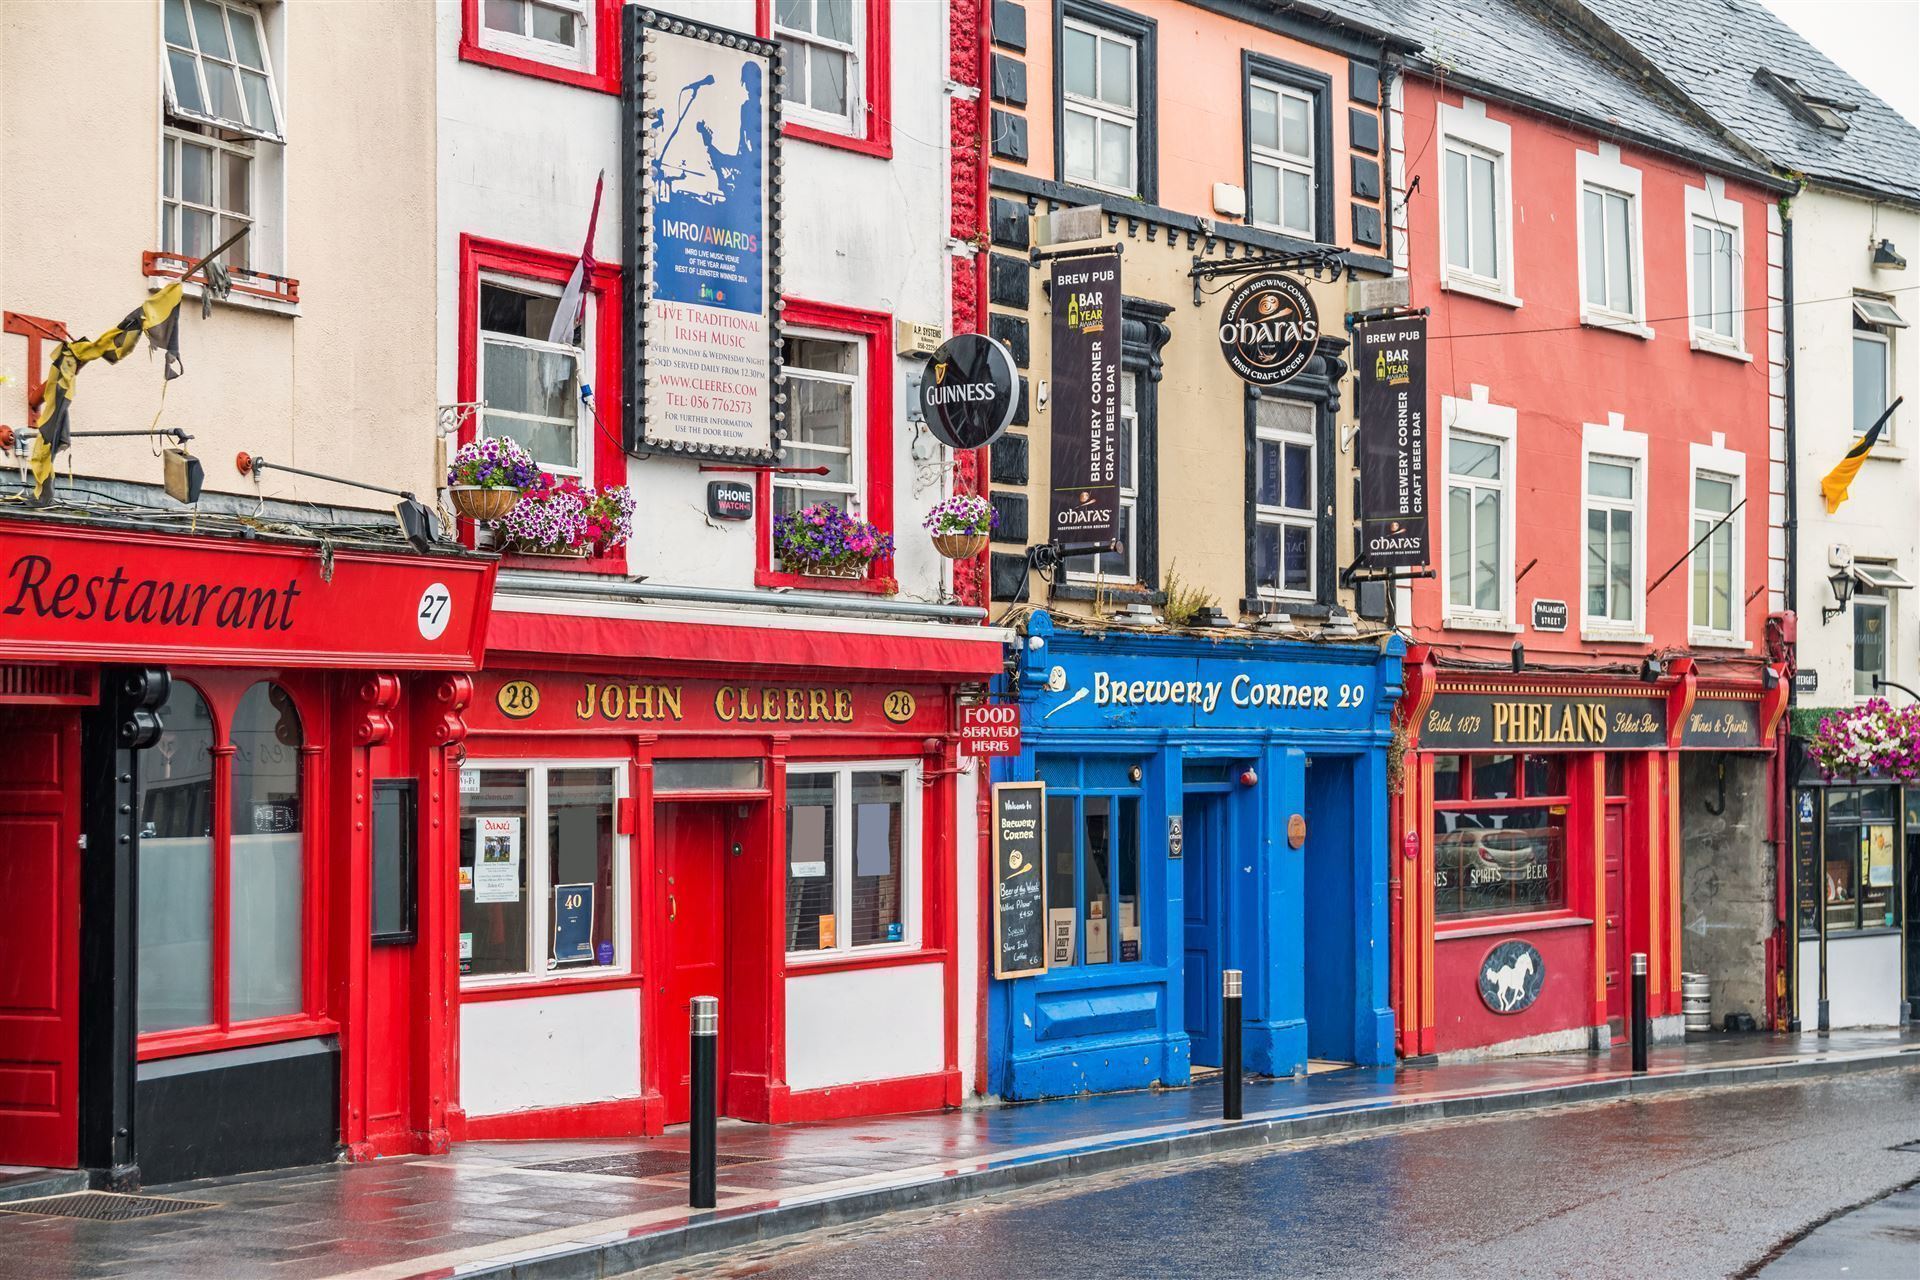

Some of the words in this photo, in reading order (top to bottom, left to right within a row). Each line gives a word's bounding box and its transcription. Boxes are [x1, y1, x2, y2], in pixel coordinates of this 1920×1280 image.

[685, 248, 698, 256] IMRO
[698, 250, 709, 258] LIVE
[710, 251, 725, 261] MUSIC
[697, 259, 707, 267] THE
[707, 260, 720, 269] YEAR
[720, 262, 737, 272] AWARD
[1058, 272, 1089, 286] BREW
[1092, 270, 1114, 282] PUB
[1079, 291, 1103, 307] BAR
[1227, 287, 1251, 321] CARLOW
[1250, 279, 1287, 291] BREWING
[1287, 285, 1311, 318] COMPANY
[657, 304, 682, 320] LIVE
[686, 308, 760, 333] TRADITIONAL
[1080, 309, 1103, 321] YEAR
[675, 325, 707, 343] IRISH
[711, 330, 746, 348] MUSIC
[923, 327, 942, 338] SYSTEMS
[1366, 333, 1396, 344] BREW
[1399, 331, 1420, 341] PUB
[672, 347, 701, 358] MONDAY
[703, 350, 708, 358] &
[709, 351, 744, 363] WEDNESDAY
[745, 356, 765, 366] NIGHT
[1231, 356, 1252, 375] IRISH
[1250, 370, 1280, 380] CRAFT
[1280, 353, 1305, 377] BEERS
[1386, 349, 1409, 362] BAR
[654, 358, 672, 367] OOD
[673, 360, 699, 370] SERVED
[701, 362, 720, 373] DAILY
[722, 366, 740, 376] FROM
[1092, 341, 1102, 404] CORNER
[1386, 364, 1409, 375] YEAR
[659, 374, 758, 397] WWW.CLEERES.COM
[1107, 364, 1115, 393] BAR
[666, 392, 688, 407] TEL:
[690, 395, 709, 409] 056
[712, 398, 752, 414] 7762573
[926, 383, 996, 406] GUINNESS
[664, 411, 678, 421] FOR
[679, 413, 709, 424] FURTHER
[710, 416, 753, 428] INFORMATION
[1106, 397, 1115, 431] BEER
[1398, 392, 1408, 447] CORNER
[1412, 412, 1421, 436] BAR
[675, 424, 687, 433] USE
[689, 425, 701, 435] THE
[703, 427, 722, 436] DOOR
[723, 429, 744, 438] BELOW
[1091, 409, 1101, 482] BREWERY
[1413, 440, 1421, 470] BEER
[1105, 436, 1114, 481] CRAFT
[1398, 451, 1409, 514] BREWERY
[1413, 473, 1422, 513] CRAFT
[718, 489, 751, 502] PHONE
[719, 501, 744, 510] WATCH
[4, 554, 301, 631] Restaurant
[420, 594, 448, 624] 27
[1537, 604, 1565, 615] PARLIAMENT
[1541, 616, 1561, 625] STREET
[507, 685, 533, 710] 28
[576, 683, 684, 722] JOHN
[713, 686, 855, 723] CLEERE
[1093, 671, 1222, 713] Brewery
[1231, 674, 1329, 709] Corner
[1337, 684, 1365, 709] 29
[889, 694, 911, 715] 28
[965, 707, 1016, 724] FOOD
[962, 726, 1019, 738] SERVED
[1428, 709, 1452, 733] Estd.
[1457, 715, 1481, 734] 1873
[1492, 702, 1608, 744] PHELANS
[1612, 711, 1639, 734] Select
[1639, 712, 1660, 734] Bar
[1691, 713, 1712, 733] Wines
[1714, 719, 1721, 732] &
[1722, 713, 1748, 739] Spirits
[972, 740, 1010, 753] HERE
[255, 808, 294, 828] OPEN
[1470, 867, 1502, 884] SPIRITS
[1526, 864, 1548, 880] BEER
[1000, 882, 1014, 898] Beer
[565, 894, 582, 910] 40
